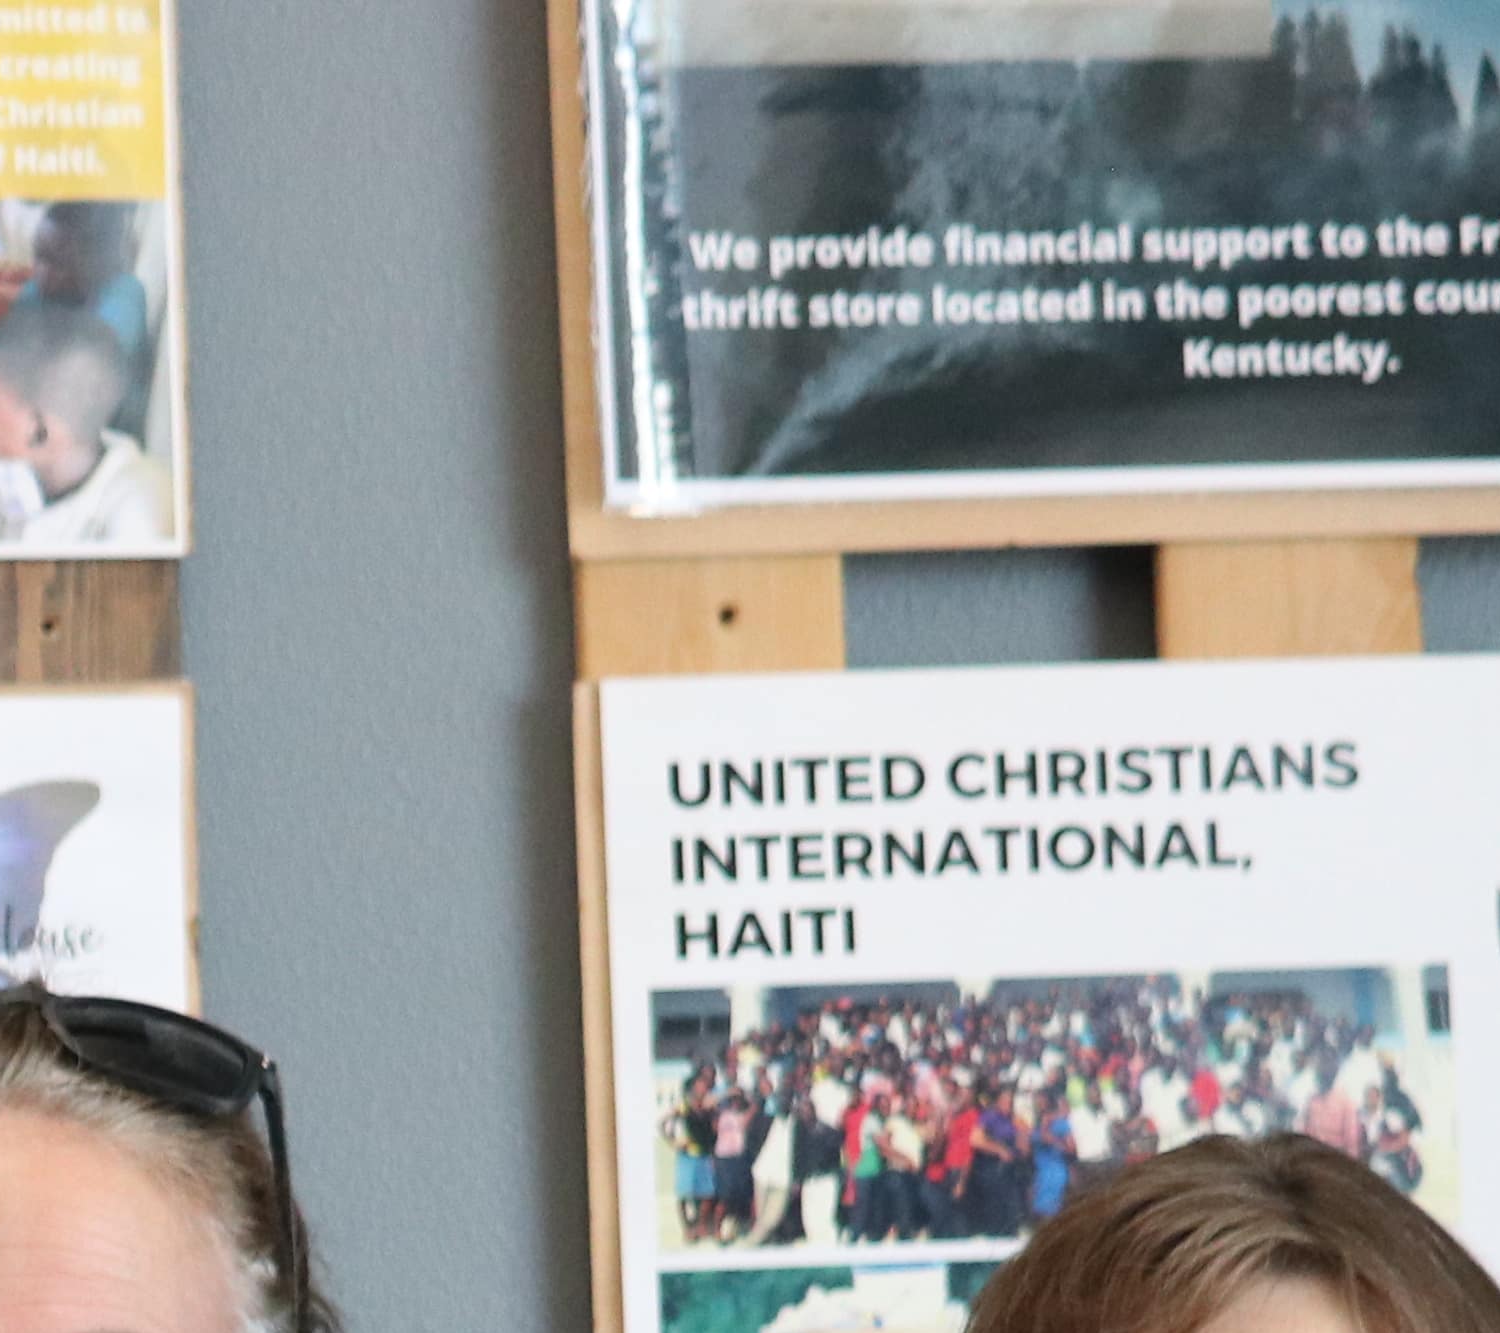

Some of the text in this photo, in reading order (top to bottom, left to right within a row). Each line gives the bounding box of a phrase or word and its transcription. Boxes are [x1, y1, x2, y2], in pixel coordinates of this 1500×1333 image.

[116, 6, 151, 36] to
[687, 231, 760, 271] We
[769, 227, 935, 279] provide
[943, 223, 1134, 266] financial
[1142, 223, 1312, 271] support
[1320, 221, 1368, 259] to
[1376, 218, 1450, 258] the
[677, 288, 800, 332] thrift
[807, 290, 924, 328] store
[931, 282, 1096, 327] located
[1102, 281, 1147, 321] in
[1153, 280, 1230, 321] the
[1237, 278, 1406, 329] poorest
[1182, 338, 1401, 384] Kentucky.
[669, 743, 1359, 807] UNITED CHRISTIANS
[672, 822, 1252, 883] INTERNATIONAL,
[675, 909, 856, 958] HAITI
